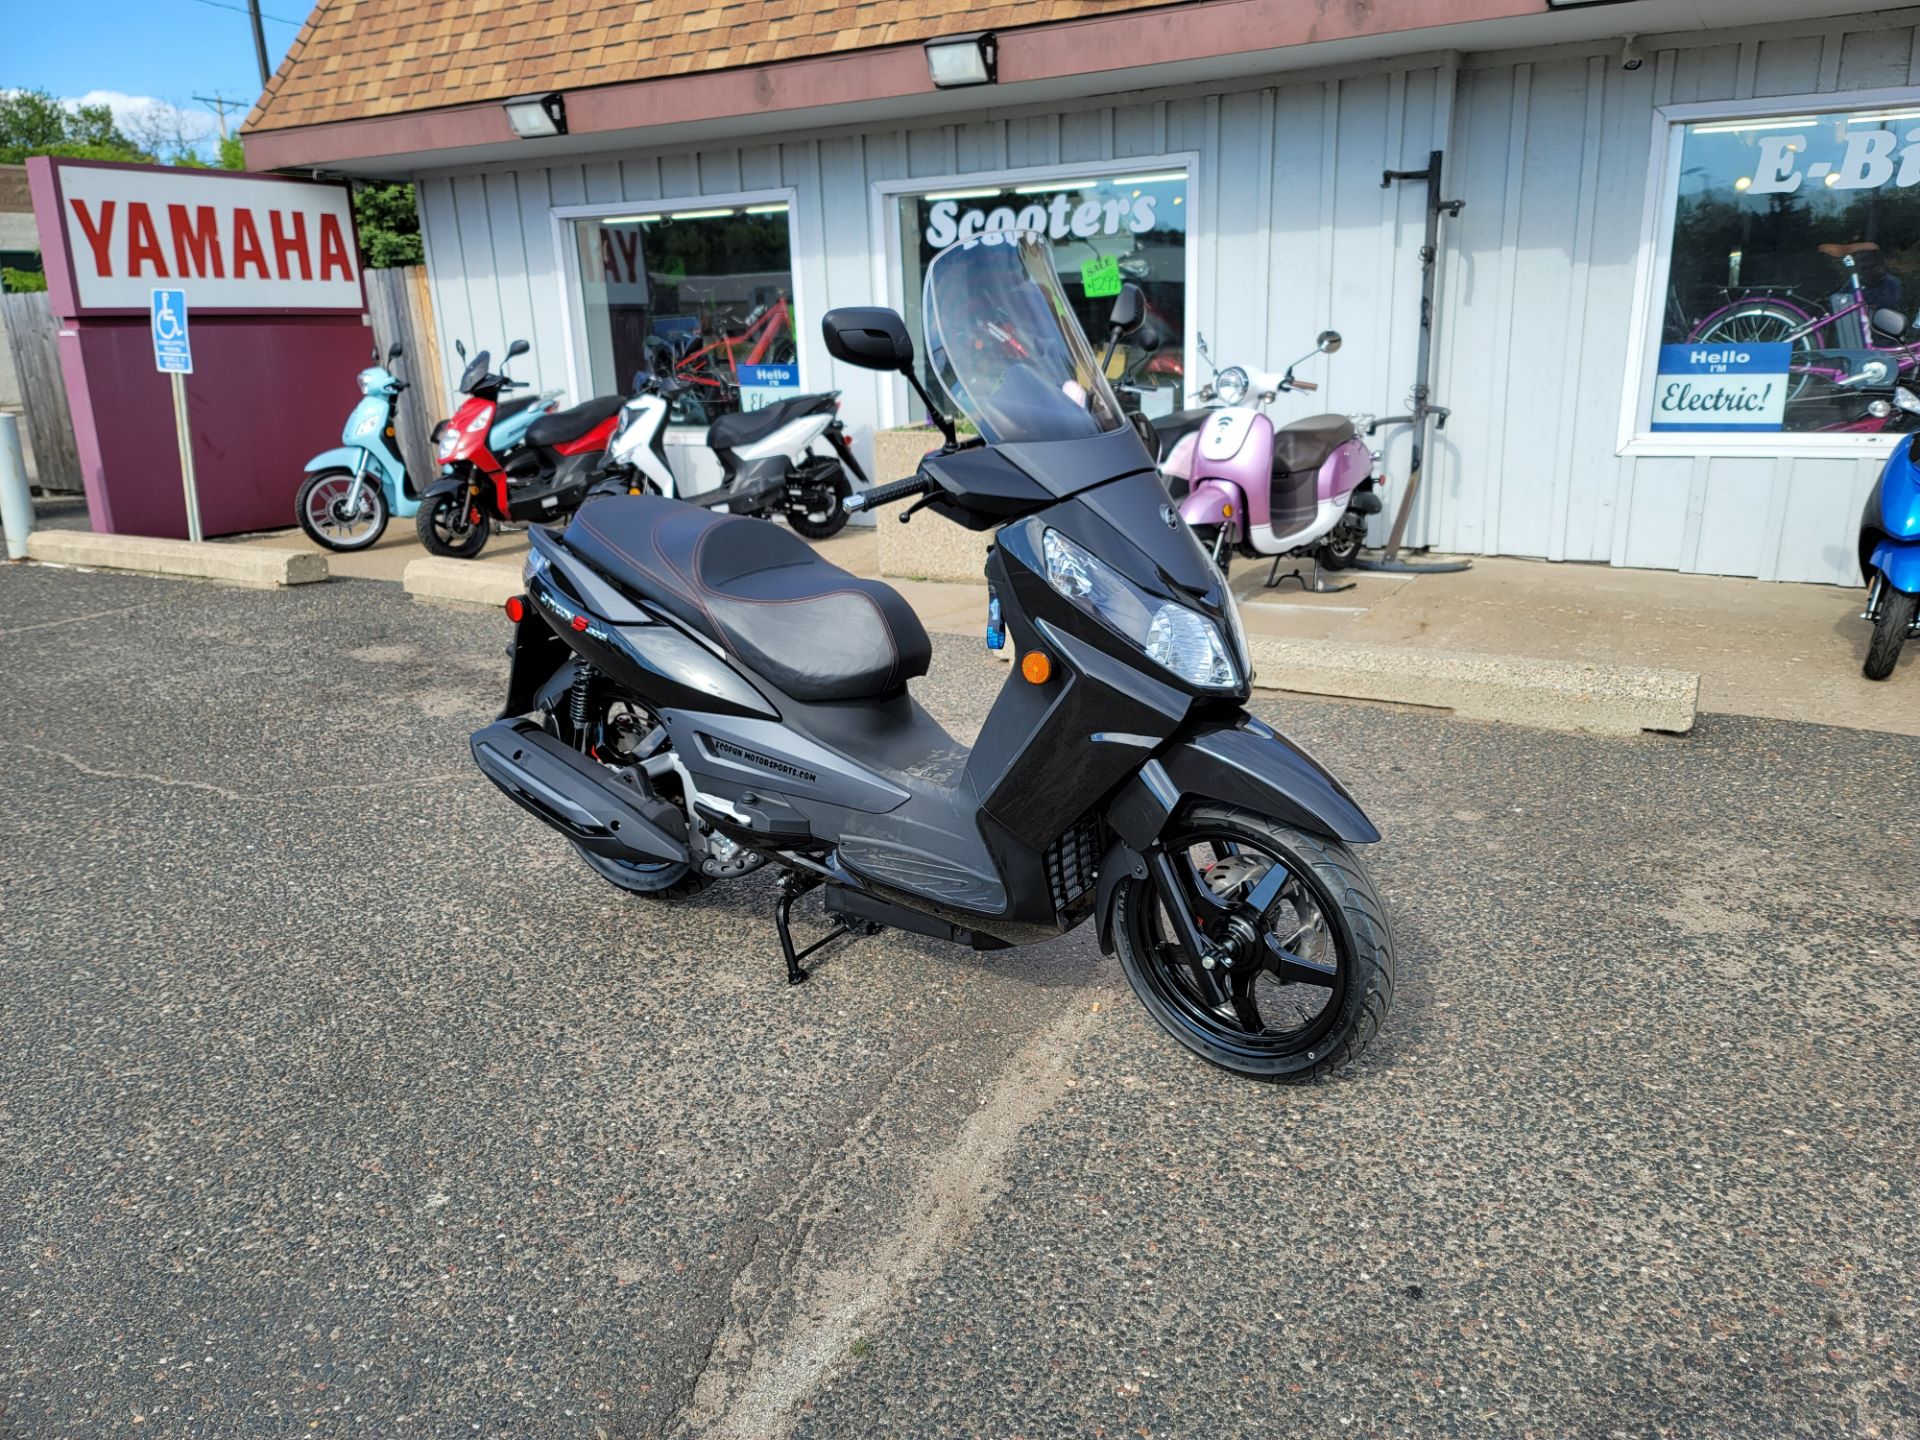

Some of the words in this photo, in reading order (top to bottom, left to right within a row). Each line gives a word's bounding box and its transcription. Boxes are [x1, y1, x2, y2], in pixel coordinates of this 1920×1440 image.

[925, 193, 1157, 249] Scooters
[69, 198, 355, 282] YAMAHA
[1690, 350, 1751, 364] Hello
[1710, 364, 1727, 373] I'M
[756, 368, 790, 380] Hello
[1661, 382, 1772, 411] Electric!
[715, 740, 743, 757] ECOFUN
[744, 752, 817, 783] MOTORSPORTS.COM
